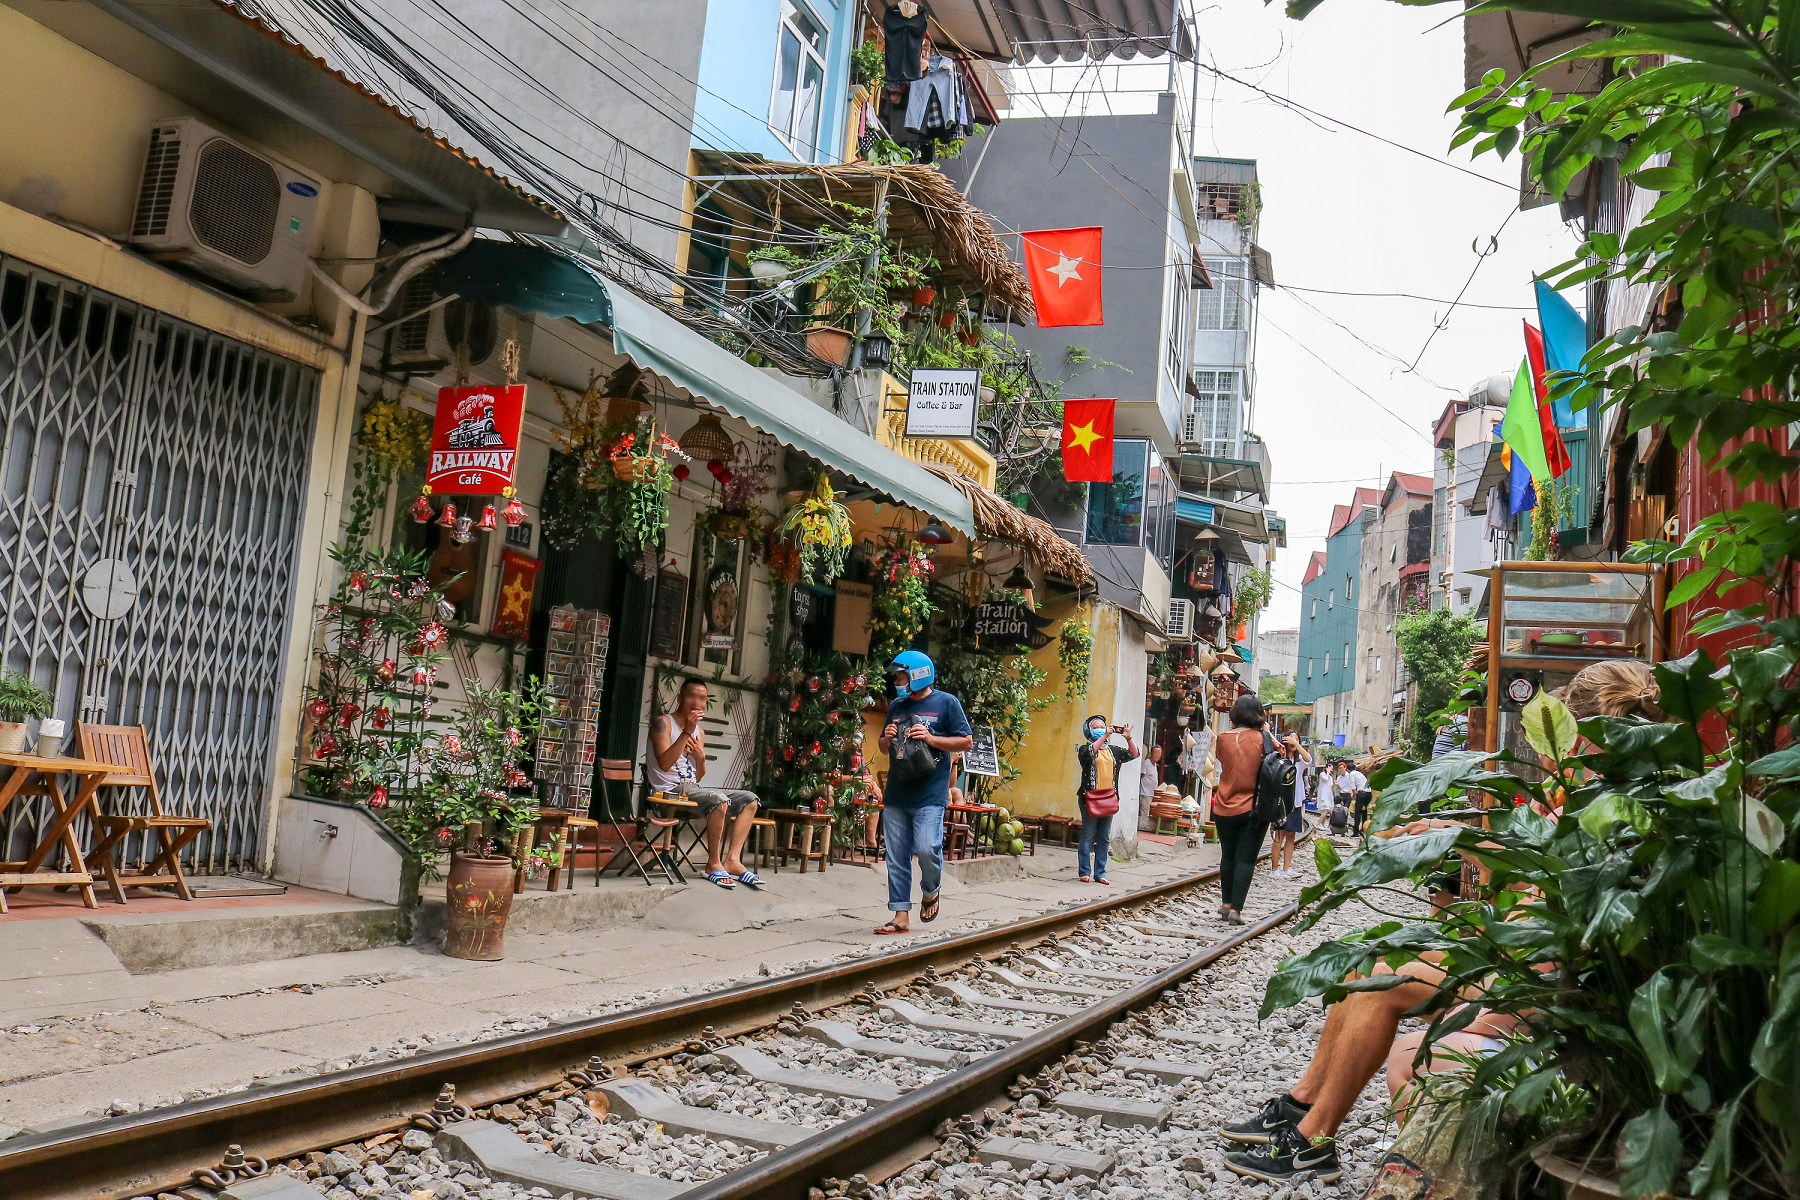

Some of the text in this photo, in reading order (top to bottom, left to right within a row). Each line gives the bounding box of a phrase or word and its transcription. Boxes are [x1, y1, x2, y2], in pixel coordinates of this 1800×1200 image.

[912, 382, 975, 397] TRAIN STATION
[916, 401, 963, 410] Coffee & Bar
[430, 453, 514, 475] RAILWAY
[458, 473, 482, 485] Café
[980, 603, 1018, 622] Train
[1031, 635, 1047, 645] 110
